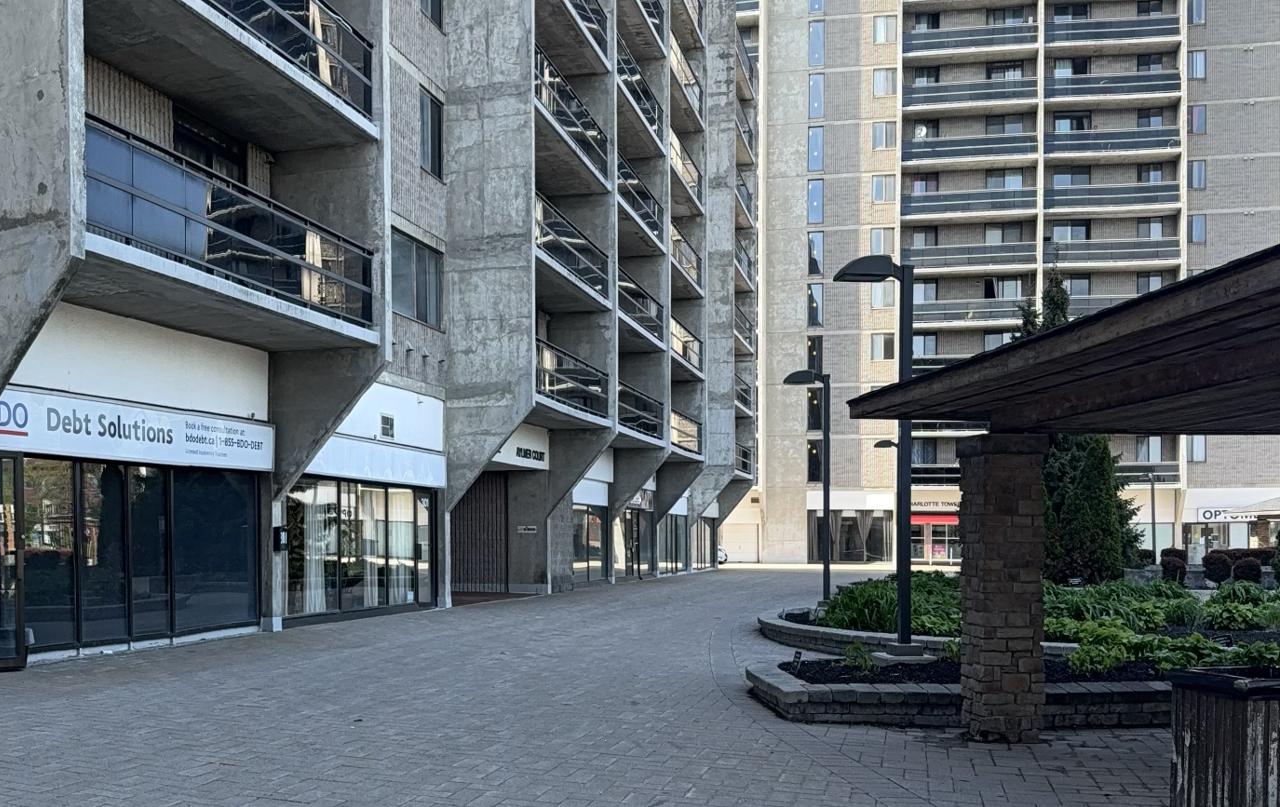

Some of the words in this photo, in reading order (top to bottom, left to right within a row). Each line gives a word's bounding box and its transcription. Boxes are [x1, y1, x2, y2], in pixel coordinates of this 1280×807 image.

[47, 407, 91, 436] Debt
[98, 414, 174, 444] Solutions
[185, 421, 196, 430] Book
[200, 422, 210, 432] free
[211, 425, 239, 435] coltation
[185, 433, 214, 445] bdodebt.ca
